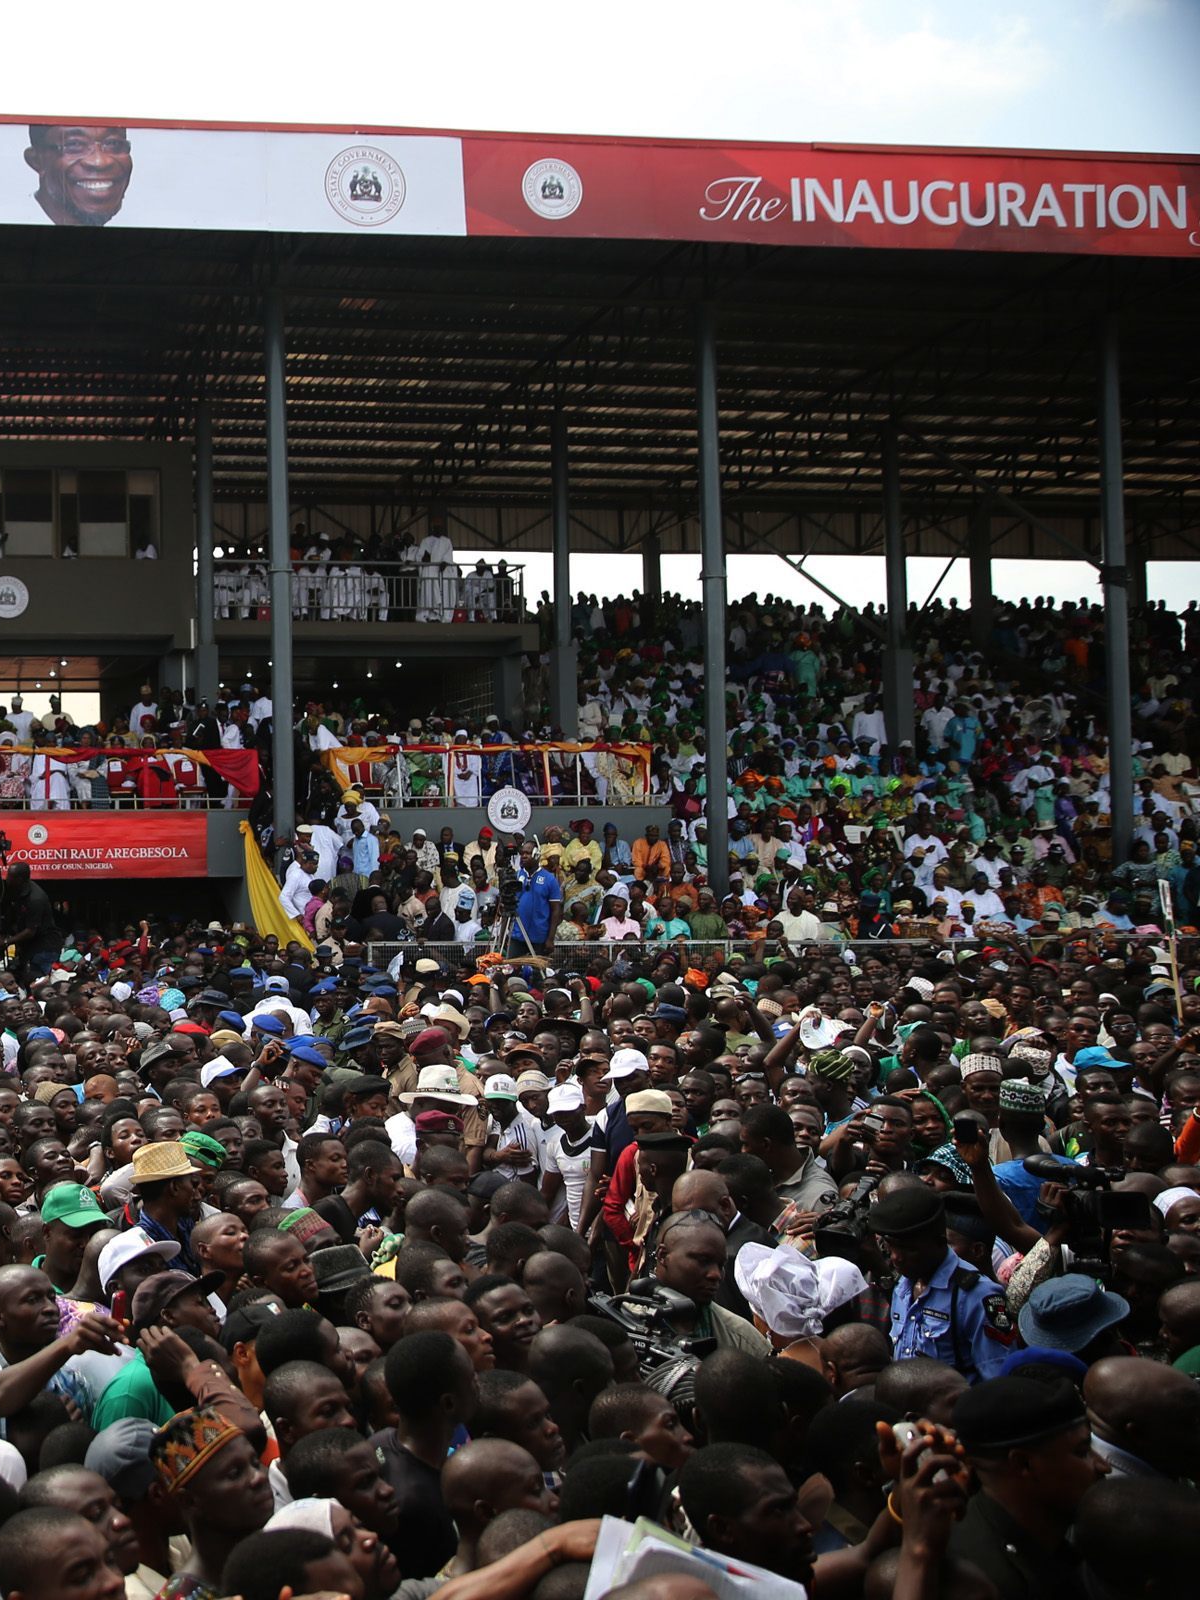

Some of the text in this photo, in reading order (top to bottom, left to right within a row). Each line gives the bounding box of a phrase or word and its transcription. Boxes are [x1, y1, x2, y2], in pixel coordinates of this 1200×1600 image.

[330, 170, 339, 198] STATE
[337, 151, 396, 175] GOVERNMENT
[699, 176, 1188, 229] The INAUGURATION
[17, 848, 67, 861] OGBENI
[70, 847, 104, 860] RAUF
[105, 846, 189, 859] AREGBESOLA
[29, 863, 50, 871] STATE
[85, 862, 113, 870] NIGERIA
